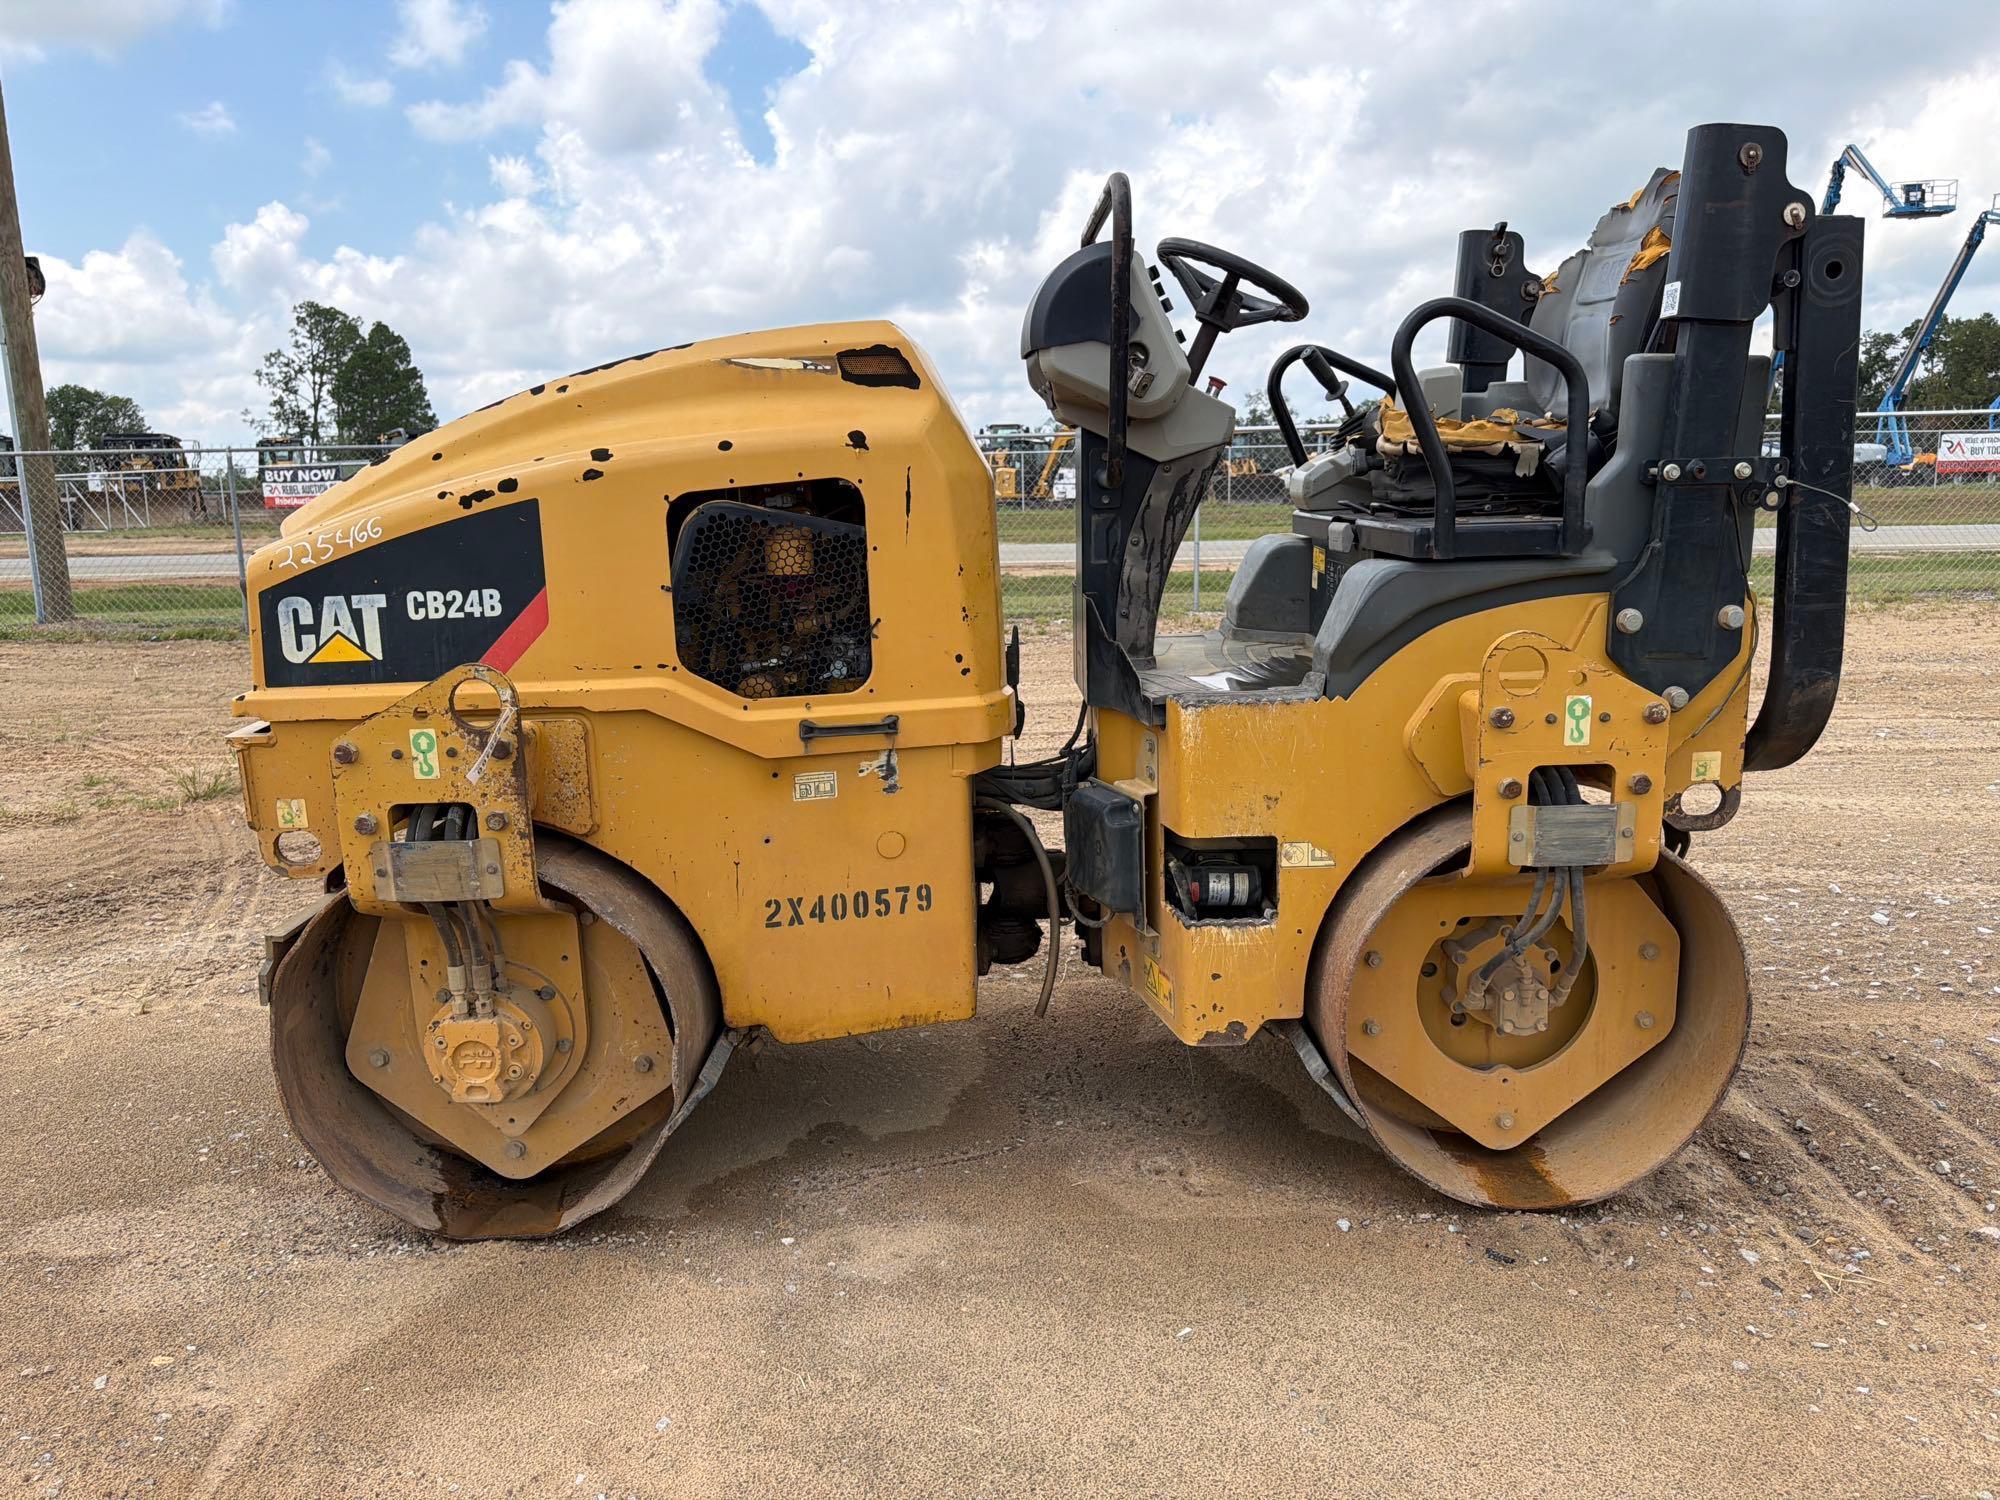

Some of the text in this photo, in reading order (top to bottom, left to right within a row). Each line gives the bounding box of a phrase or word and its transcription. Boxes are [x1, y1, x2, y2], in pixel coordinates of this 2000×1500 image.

[1970, 446, 1984, 455] BUY
[264, 468, 336, 482] BUY NOW
[282, 484, 300, 495] REBEL
[276, 516, 382, 569] 225466
[277, 588, 503, 664] CAT CB24B
[765, 884, 932, 928] 2X400579
